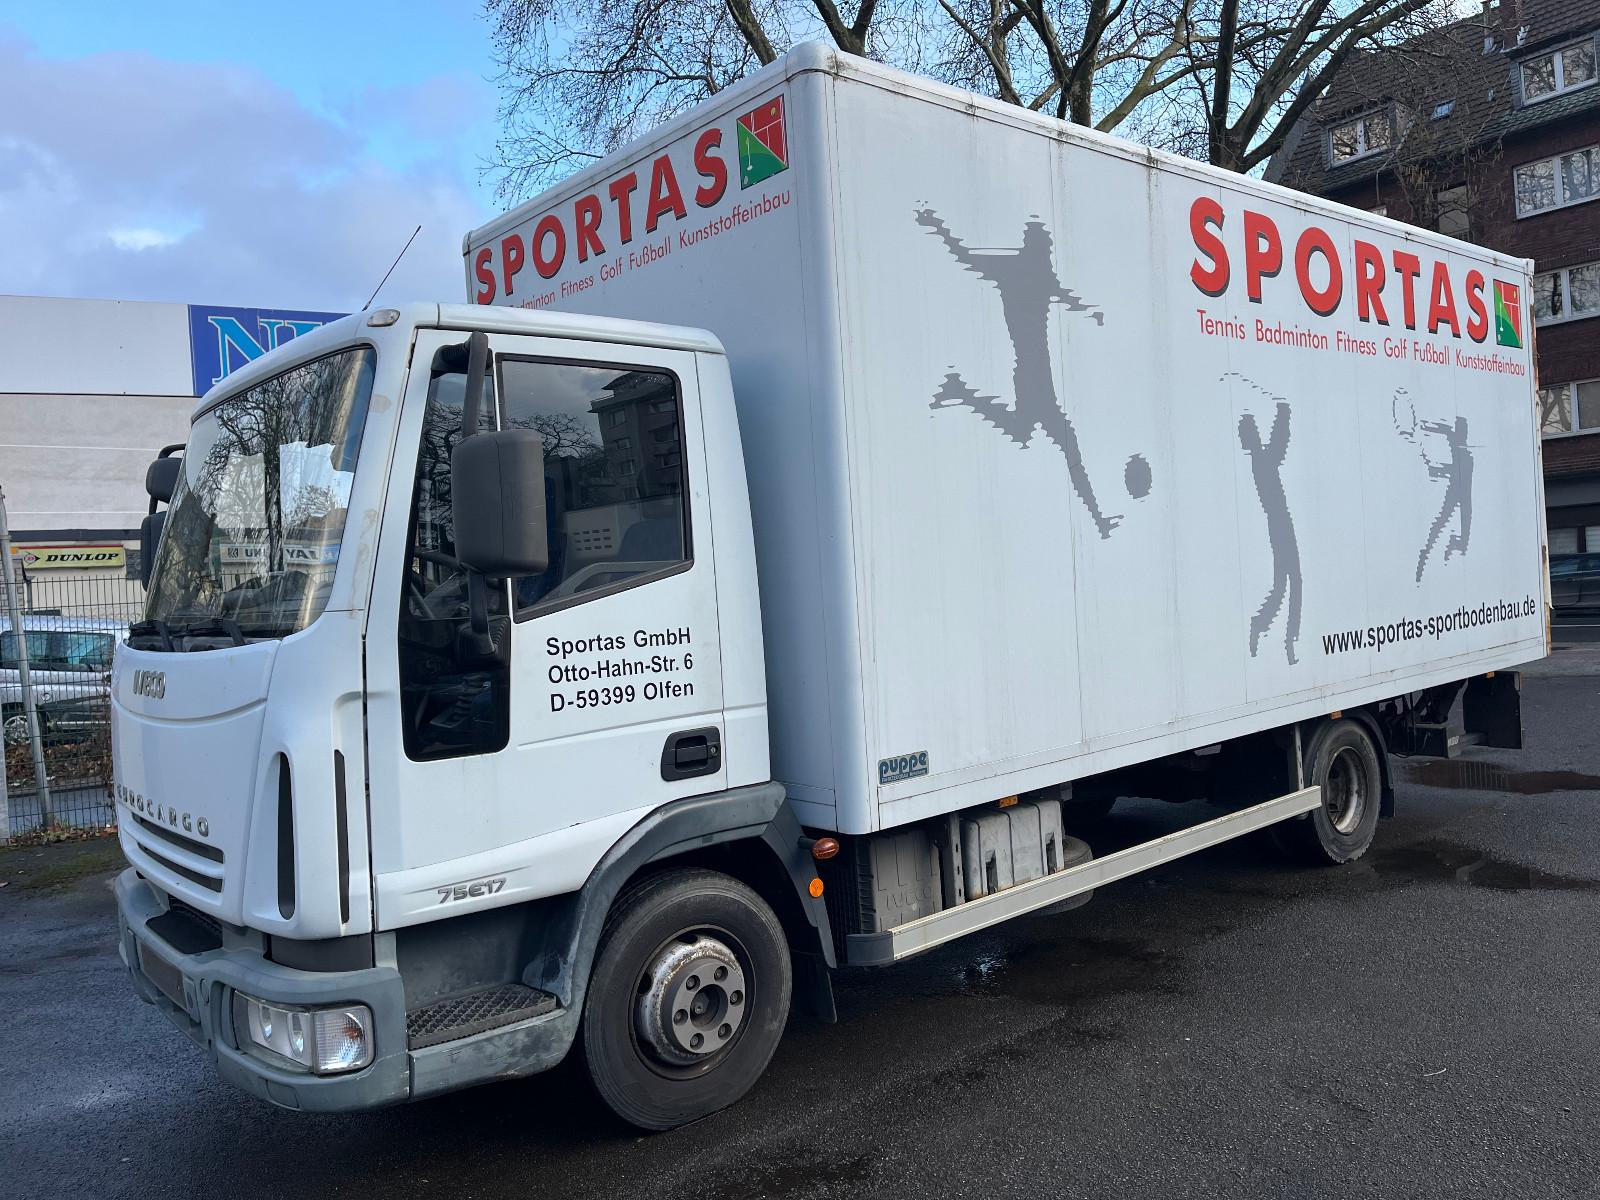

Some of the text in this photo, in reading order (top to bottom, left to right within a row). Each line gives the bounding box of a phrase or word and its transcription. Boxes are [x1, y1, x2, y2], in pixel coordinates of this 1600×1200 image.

[476, 128, 727, 305] SPORTAS
[561, 275, 594, 298] Fitness
[600, 254, 623, 281] Golf
[629, 237, 672, 272] Fußball
[679, 190, 791, 248] Kunststoffeinbau
[1189, 196, 1489, 344] SPORTAS
[1196, 309, 1526, 377] Tennis Badminton Fitness Golf Fußball Kunststoffeinbau
[45, 553, 119, 562] DUNLOP
[546, 627, 691, 659] Sportas GmbH
[1322, 594, 1536, 656] www.sportas-sportbodenbau.de
[133, 669, 166, 699] IVECO
[548, 652, 693, 684] Otto-Hahn-Str. 6
[550, 681, 694, 713] D-59399 Olfen
[880, 752, 927, 784] puppe
[117, 783, 209, 838] EUROCARGO
